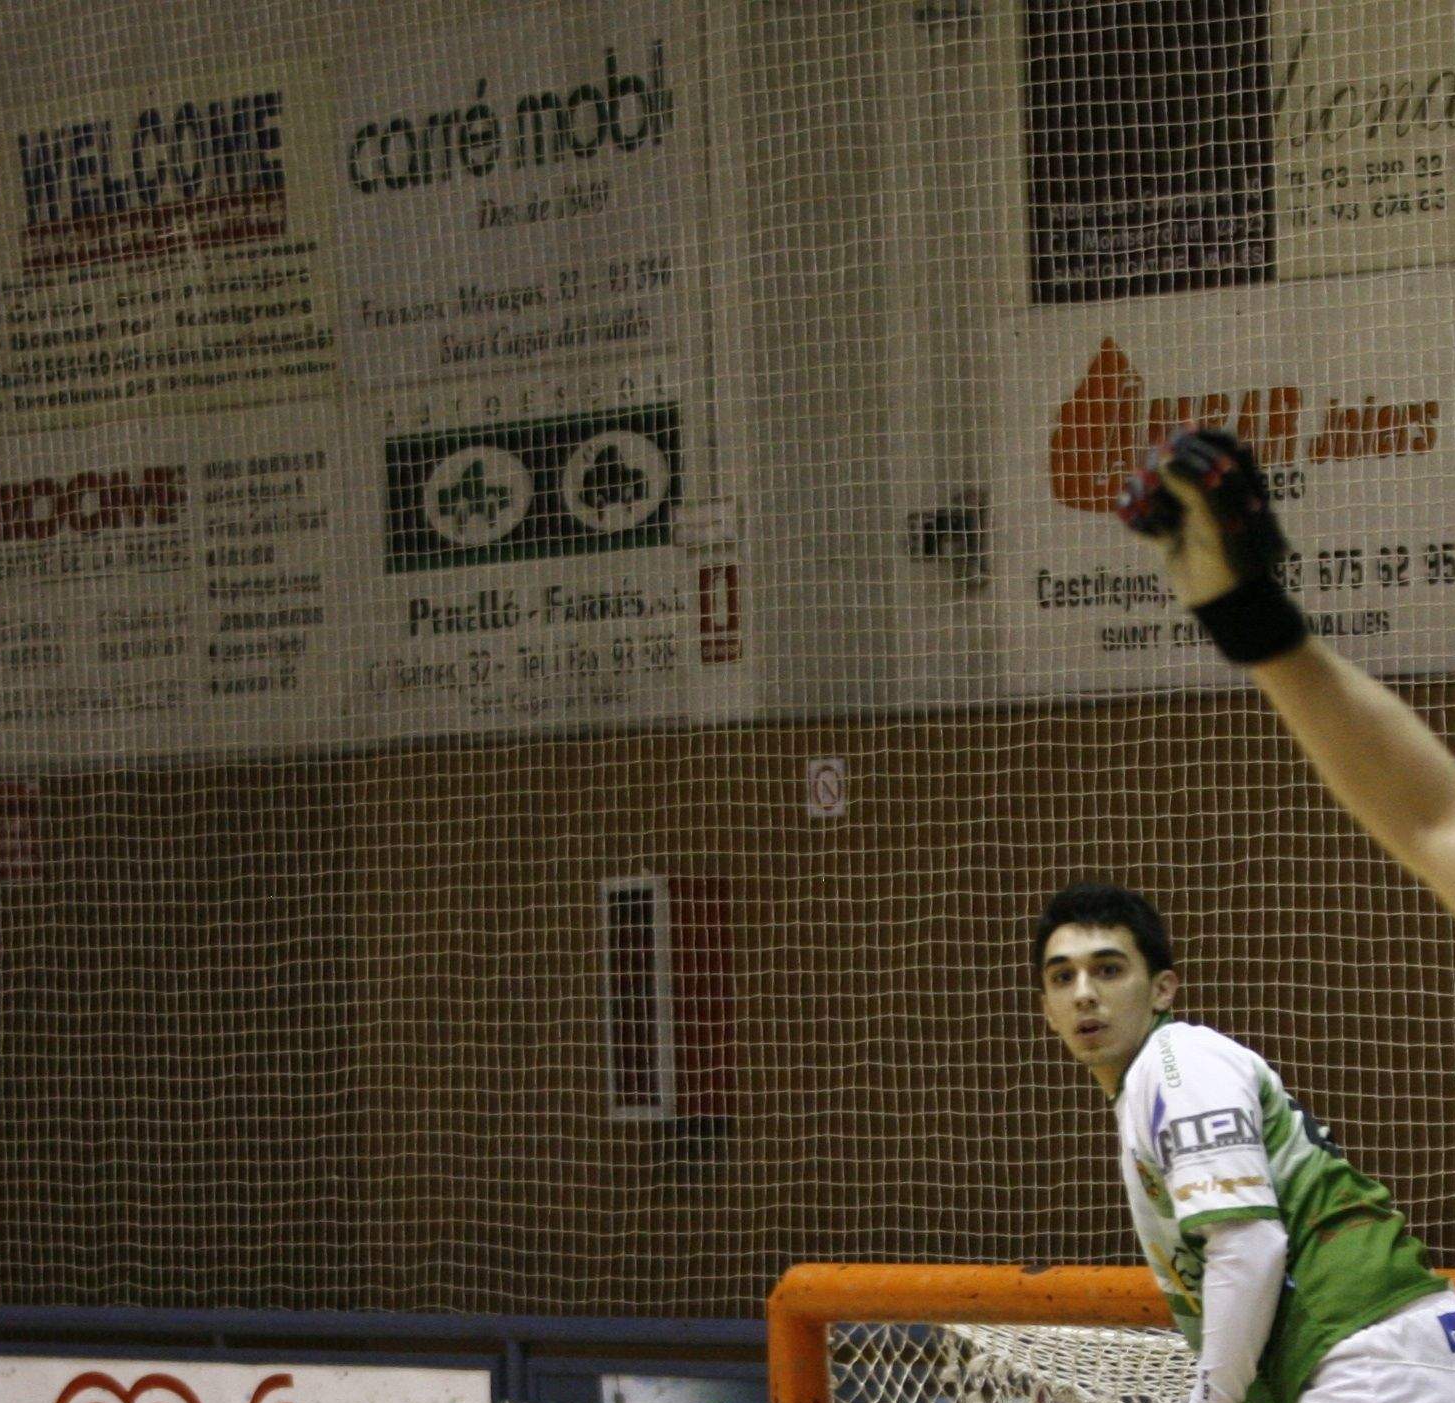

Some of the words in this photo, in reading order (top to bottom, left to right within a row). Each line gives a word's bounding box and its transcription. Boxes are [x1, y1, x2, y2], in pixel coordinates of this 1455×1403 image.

[18, 90, 283, 227] WELCOME
[349, 78, 500, 193] carré
[1308, 396, 1440, 464] joiers
[1319, 549, 1363, 591] 675
[1379, 545, 1409, 587] 62
[1101, 624, 1162, 652] SANT
